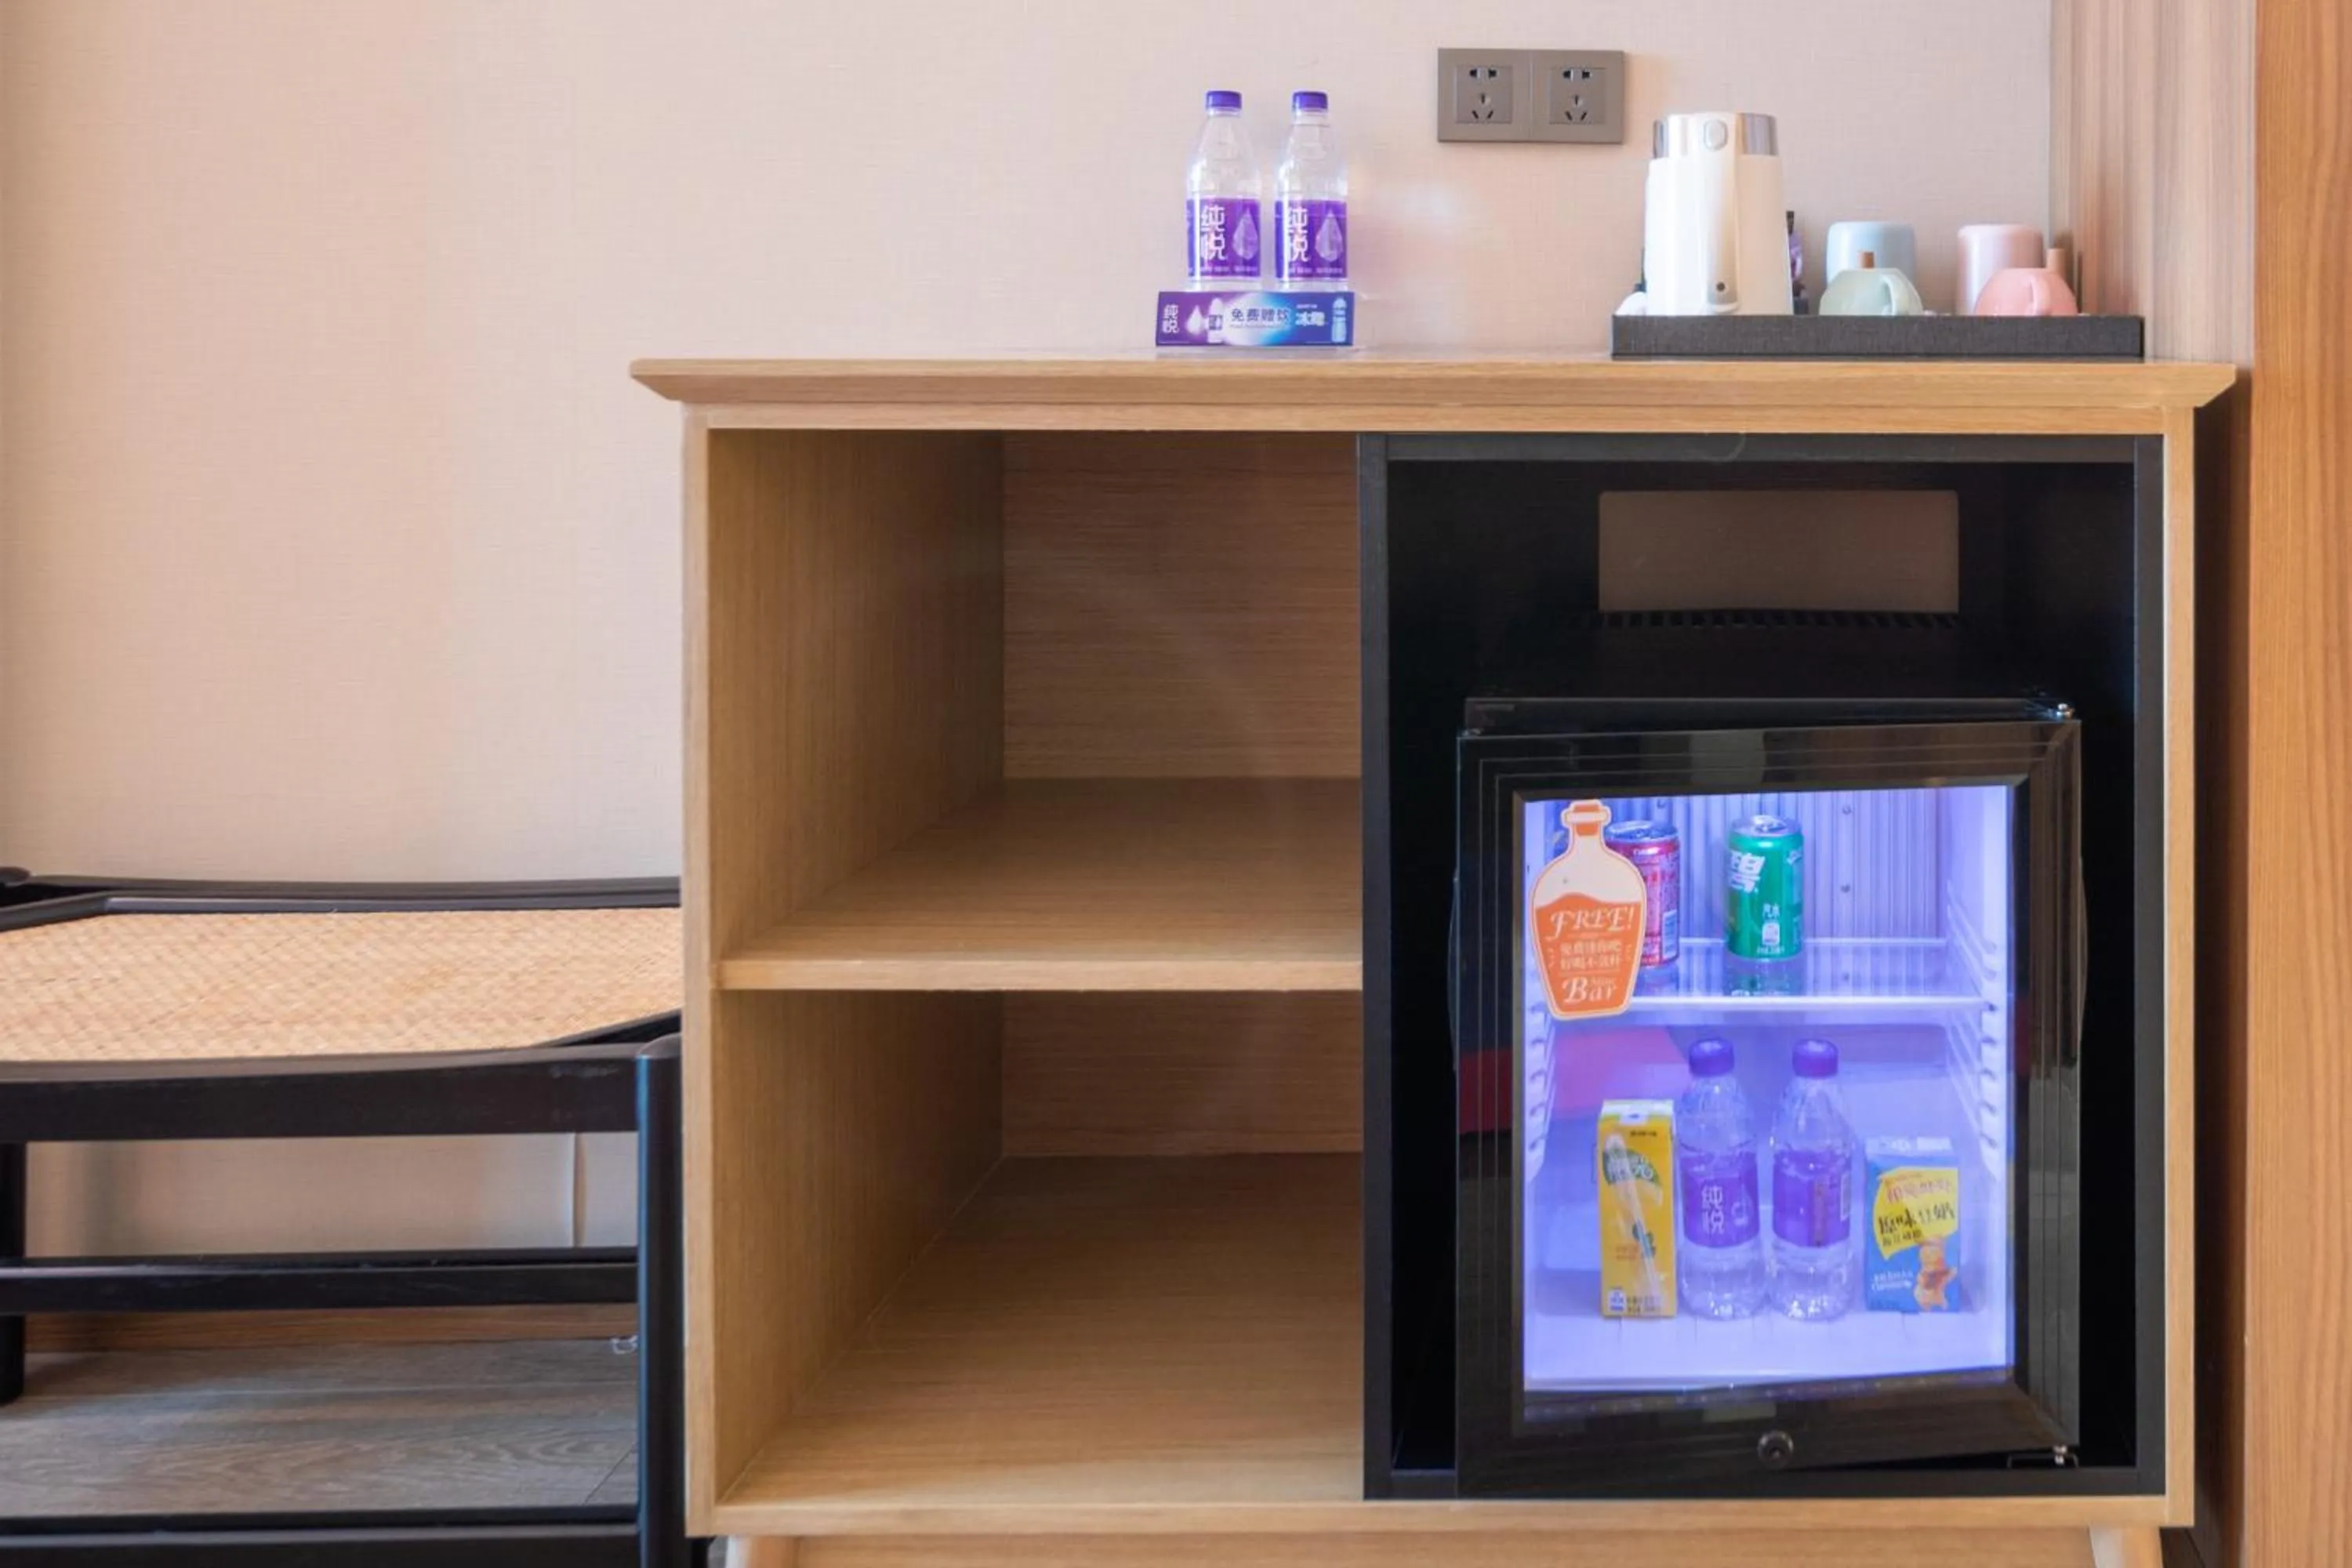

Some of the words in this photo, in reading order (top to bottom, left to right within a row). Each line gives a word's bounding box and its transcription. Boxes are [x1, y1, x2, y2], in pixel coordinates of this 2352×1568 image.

[1200, 205, 1227, 261] 纯悦
[1544, 906, 1635, 941] FREE!
[1562, 977, 1617, 1003] Bar
[1702, 1184, 1724, 1235] 纯悦
